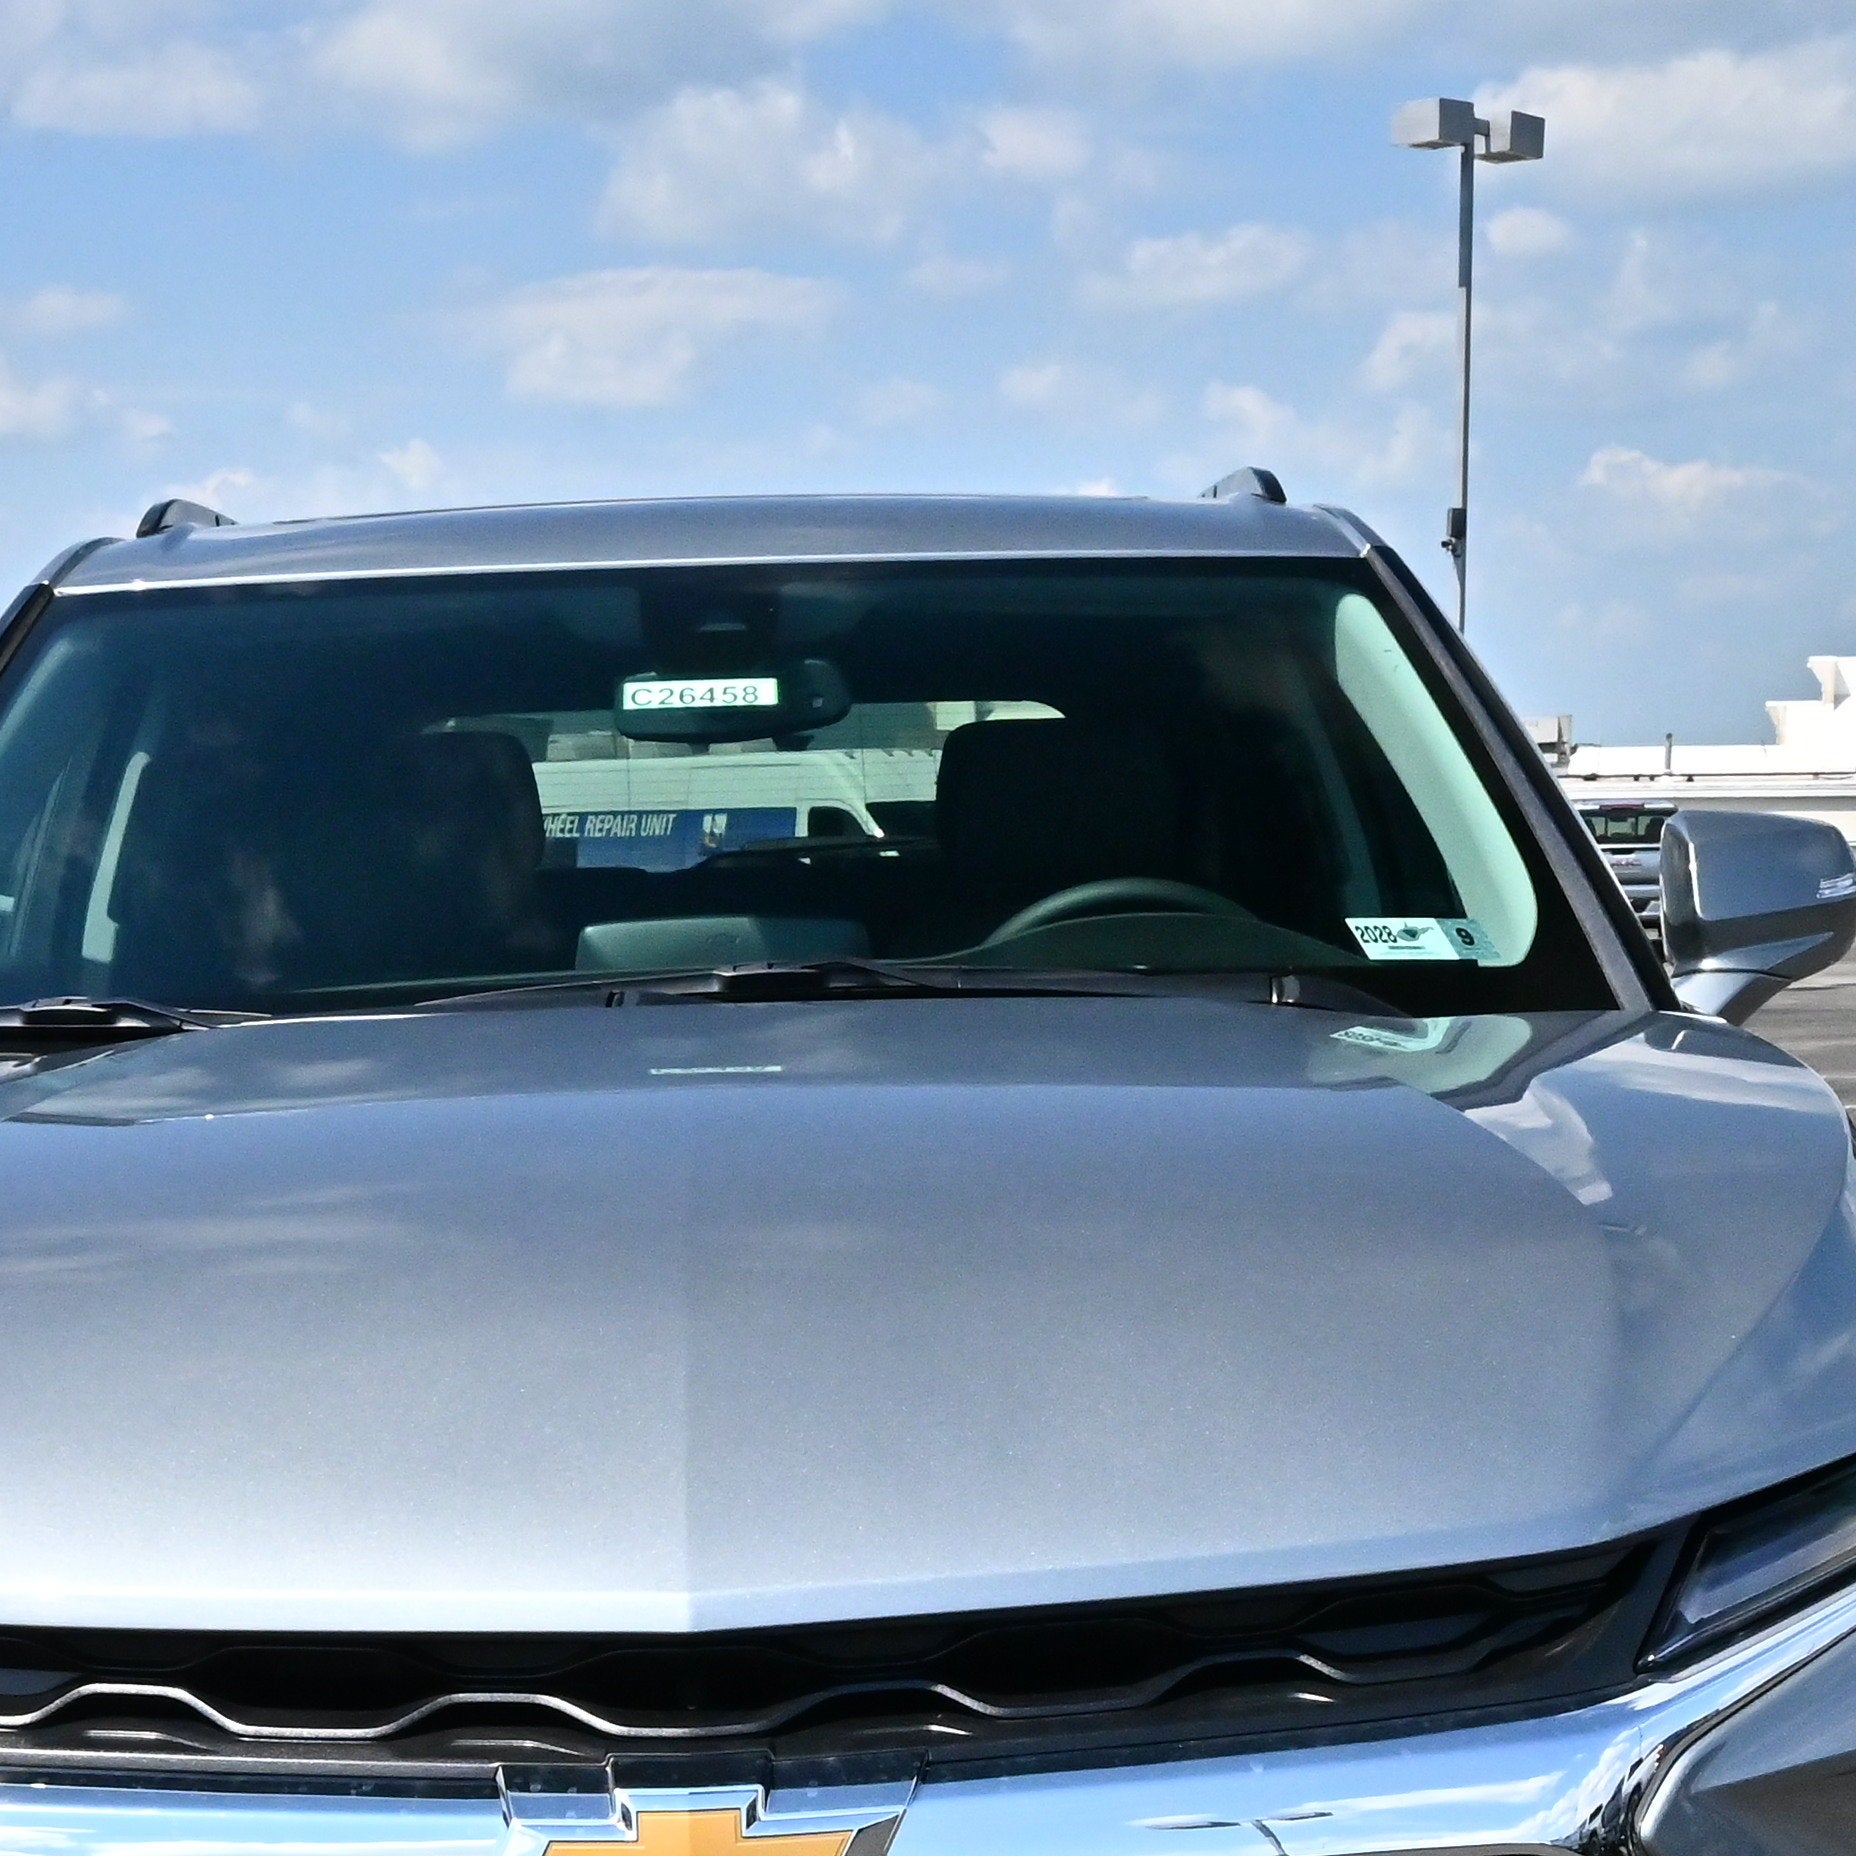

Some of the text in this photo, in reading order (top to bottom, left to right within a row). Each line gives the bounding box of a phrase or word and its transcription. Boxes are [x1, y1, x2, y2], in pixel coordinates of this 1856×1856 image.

[631, 685, 758, 706] C26458
[584, 813, 637, 838] REPAIR
[641, 812, 677, 837] UNIT
[1354, 925, 1398, 944] 2028
[1455, 927, 1475, 946] 9
